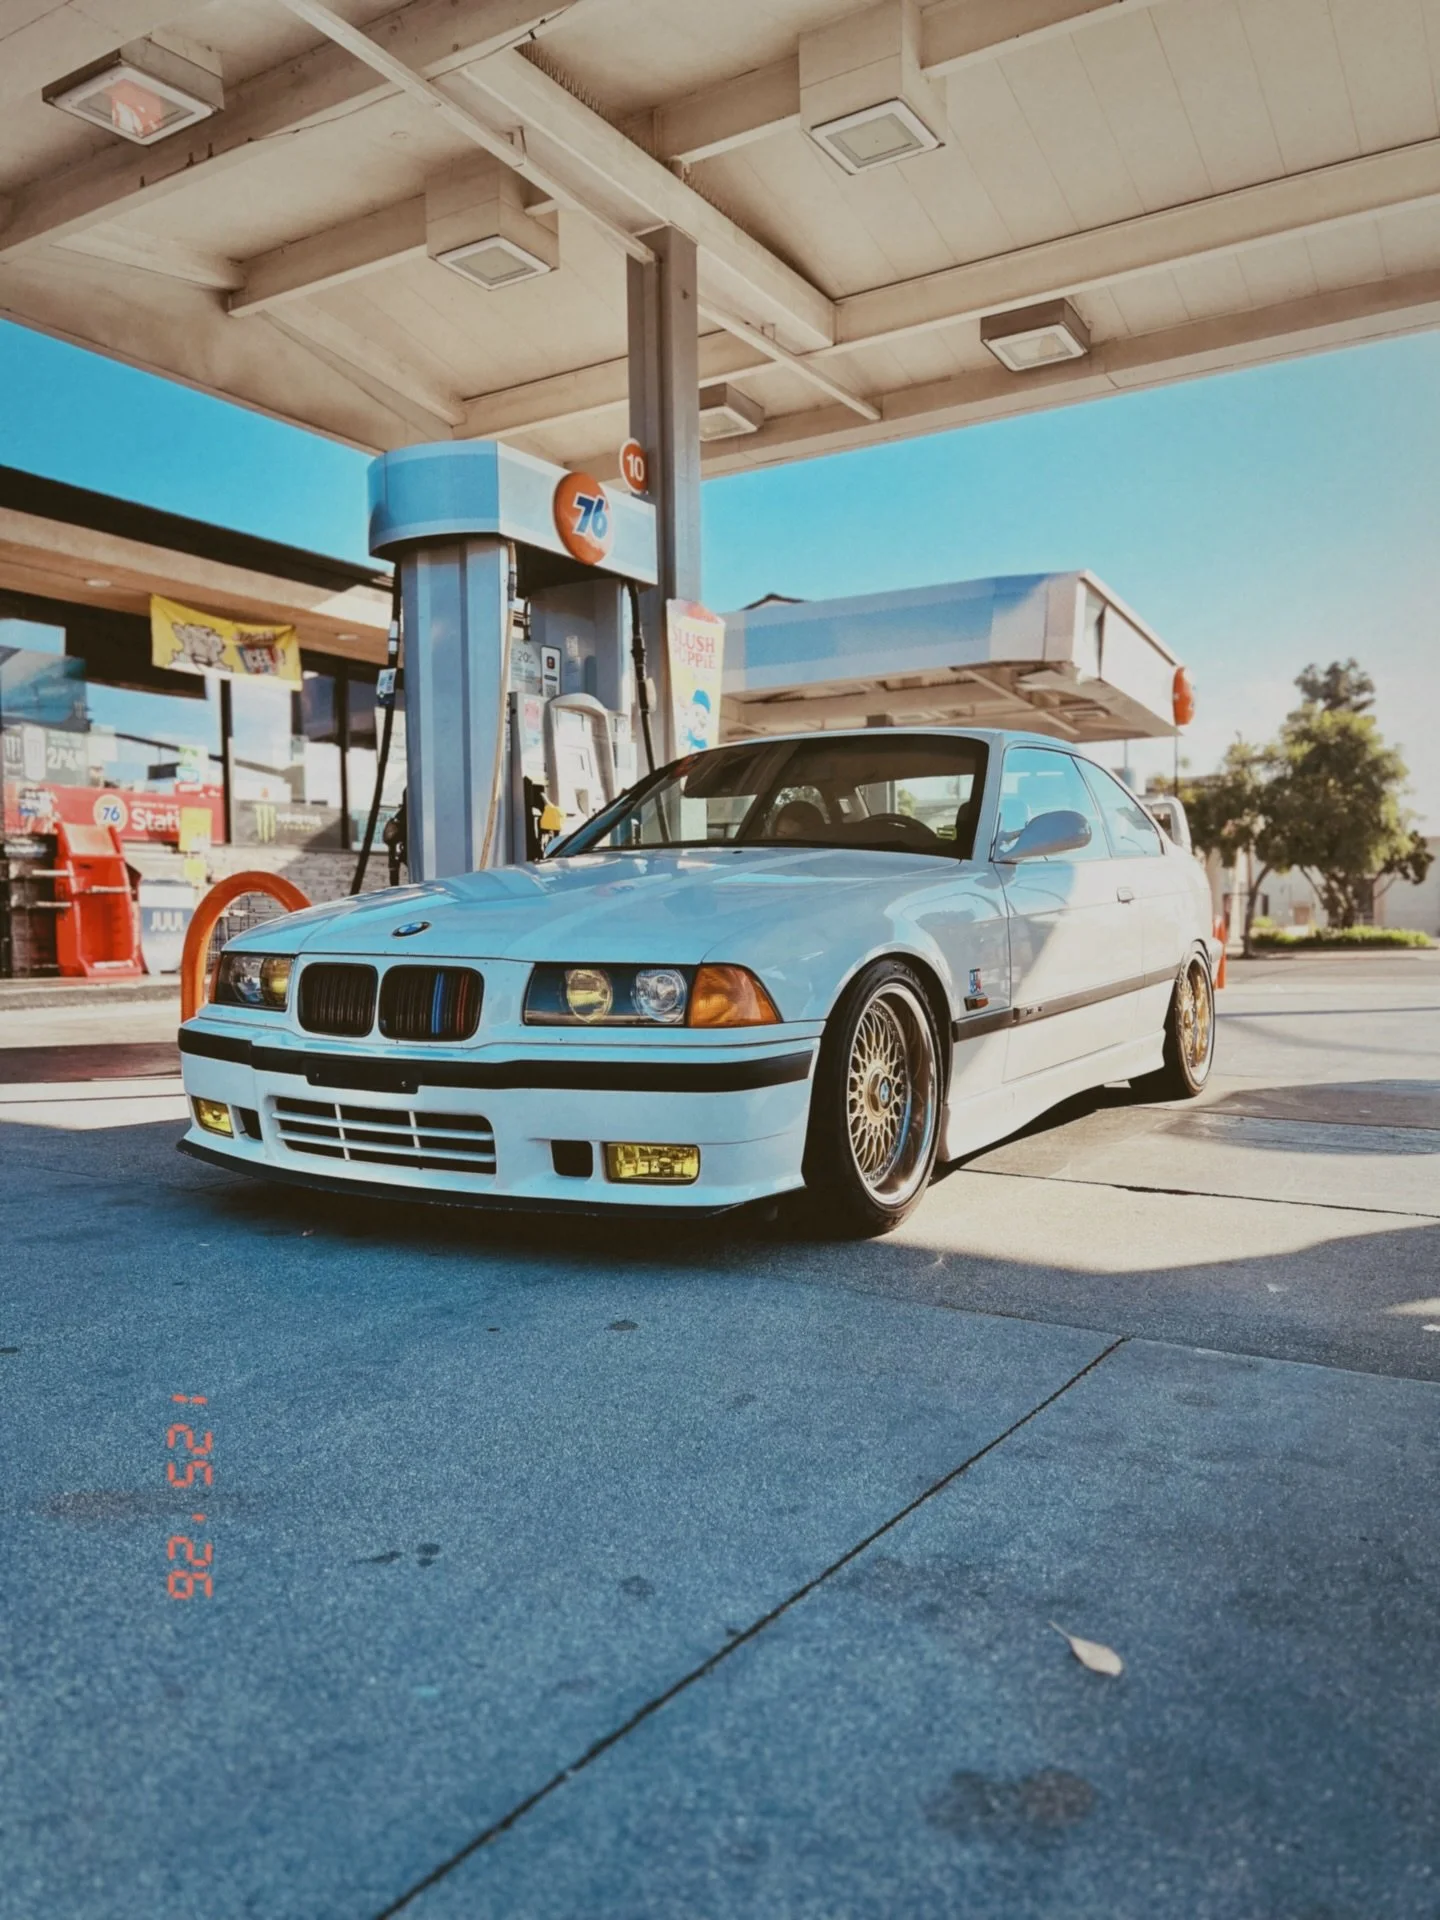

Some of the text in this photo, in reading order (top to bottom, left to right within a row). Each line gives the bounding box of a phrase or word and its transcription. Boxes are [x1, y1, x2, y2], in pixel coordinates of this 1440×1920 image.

[627, 453, 645, 482] 10
[573, 492, 608, 540] 76
[671, 624, 716, 654] SLUSH
[103, 806, 121, 822] 76
[131, 808, 180, 831] Stati
